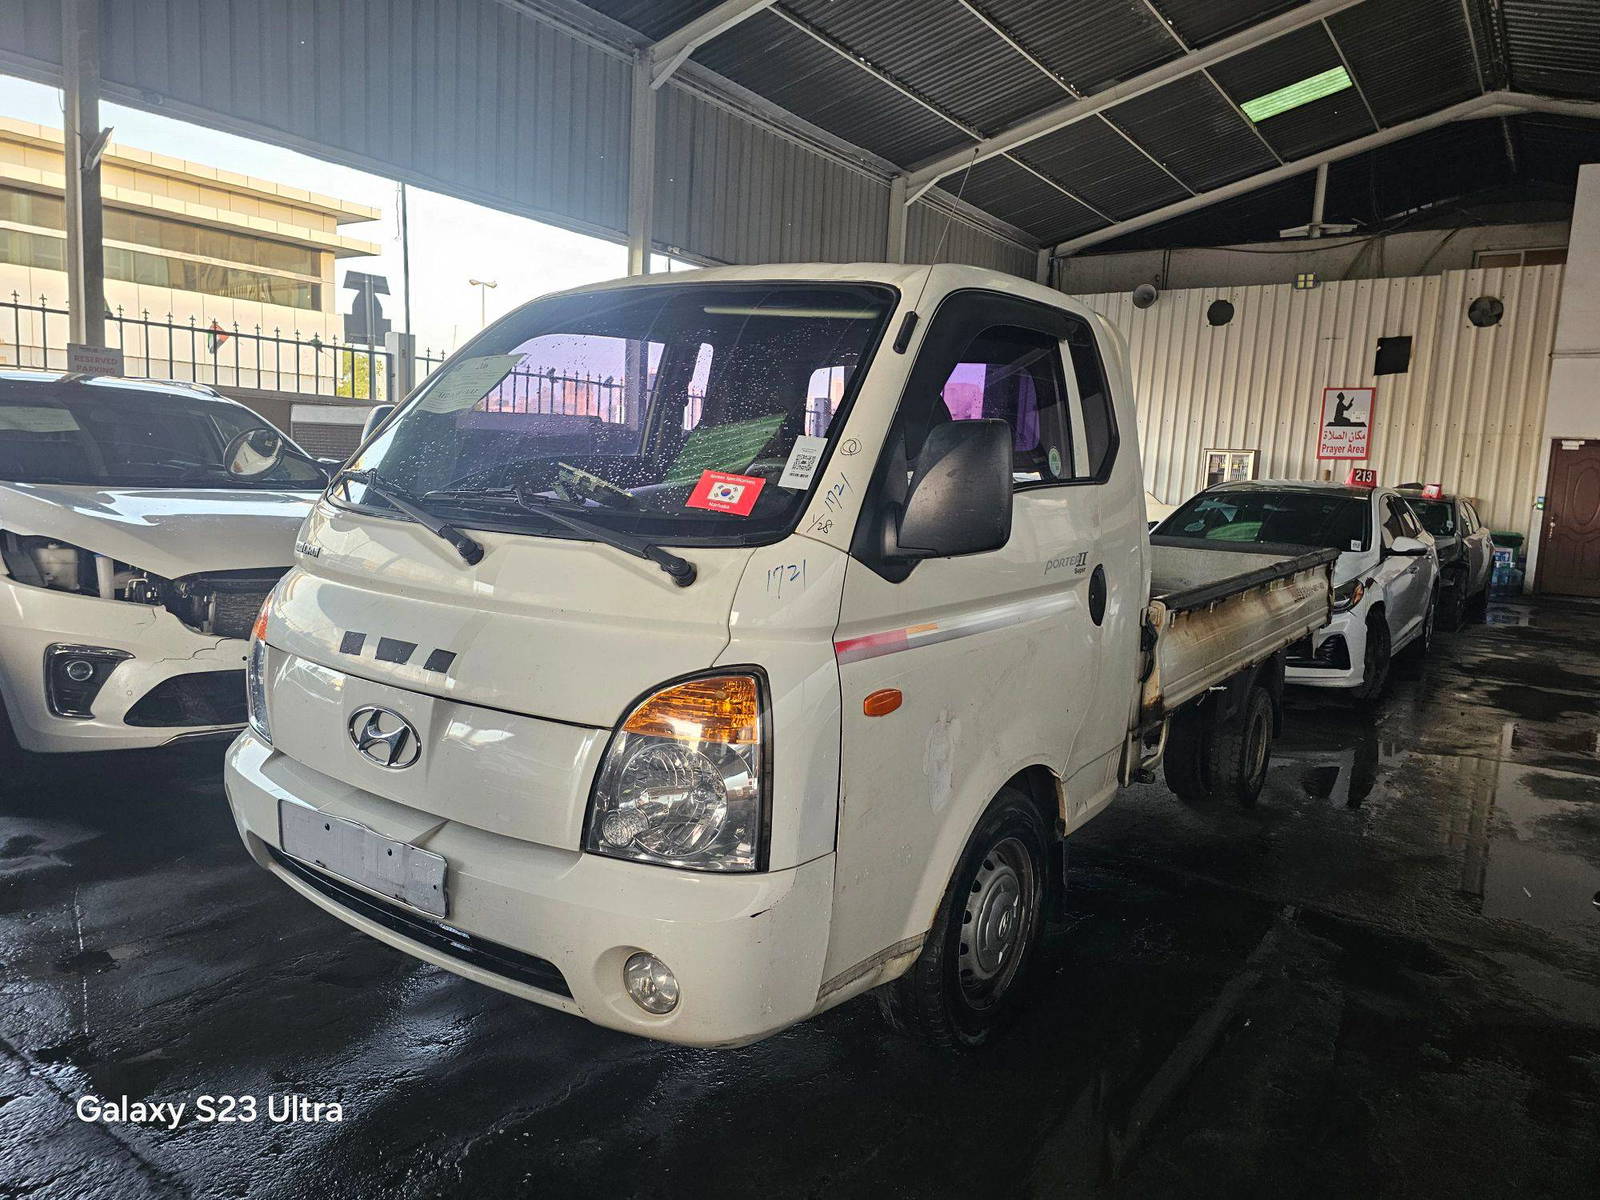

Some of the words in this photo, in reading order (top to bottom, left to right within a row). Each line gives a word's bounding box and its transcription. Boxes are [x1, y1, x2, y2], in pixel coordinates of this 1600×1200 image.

[74, 355, 118, 365] RESERVED
[1323, 430, 1348, 441] الصلاة
[1348, 430, 1366, 443] مكان
[1321, 443, 1346, 456] Prayer
[1347, 443, 1365, 454] Area
[1355, 470, 1373, 483] 213
[766, 559, 807, 600] 1721
